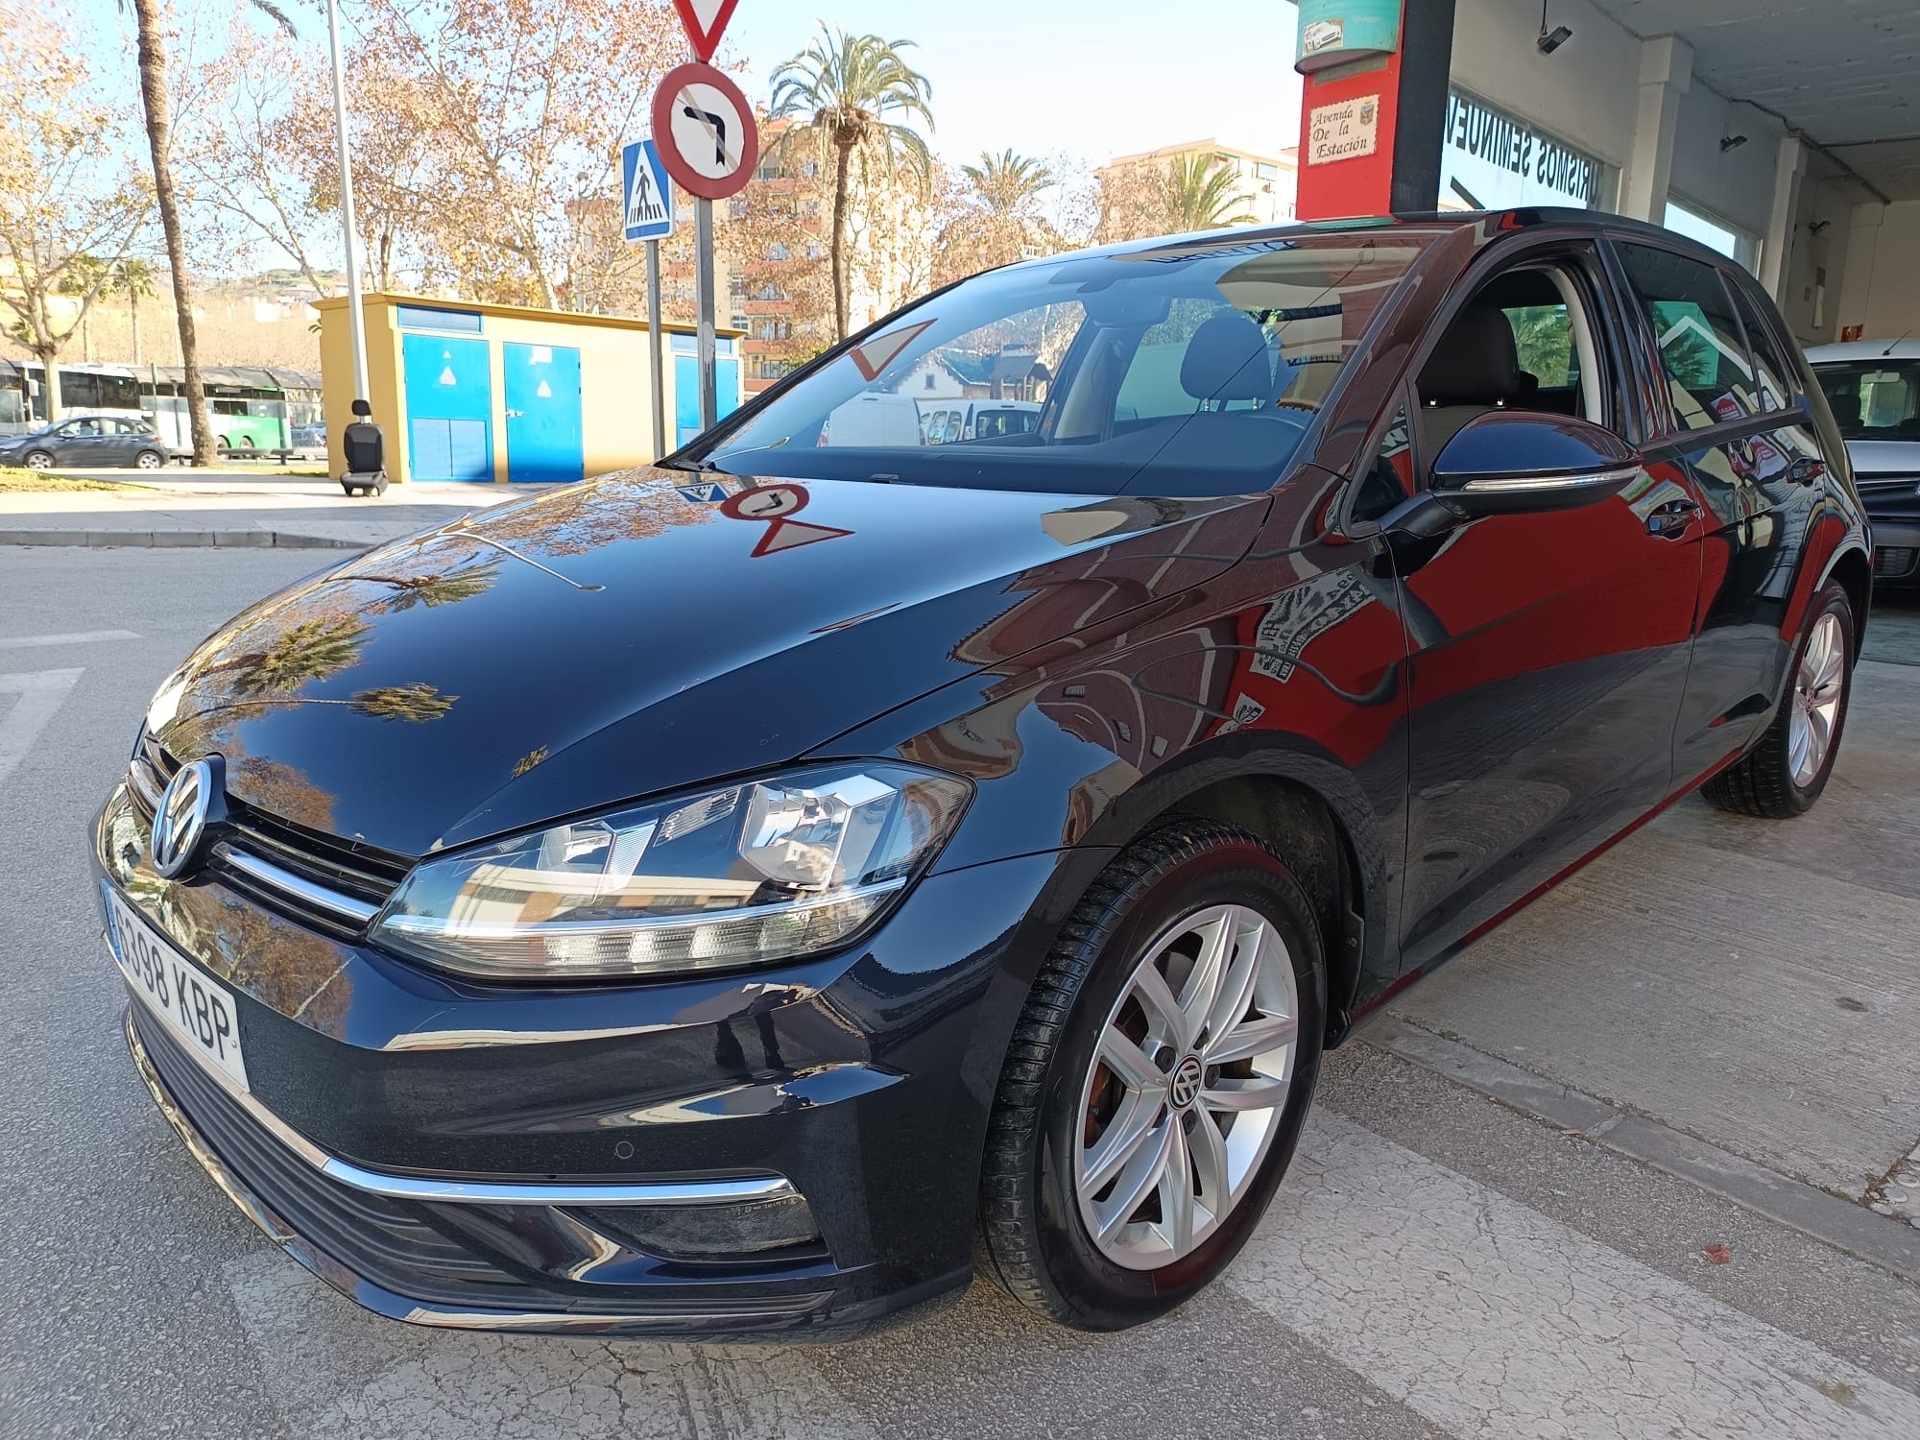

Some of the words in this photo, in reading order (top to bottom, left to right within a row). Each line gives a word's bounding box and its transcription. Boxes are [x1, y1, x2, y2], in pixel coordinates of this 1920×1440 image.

[1313, 104, 1354, 127] Avenida
[1313, 128, 1330, 142] De
[1338, 120, 1349, 136] la
[1316, 136, 1367, 159] Estación
[114, 906, 170, 1009] 6398
[172, 962, 230, 1061] KBP
